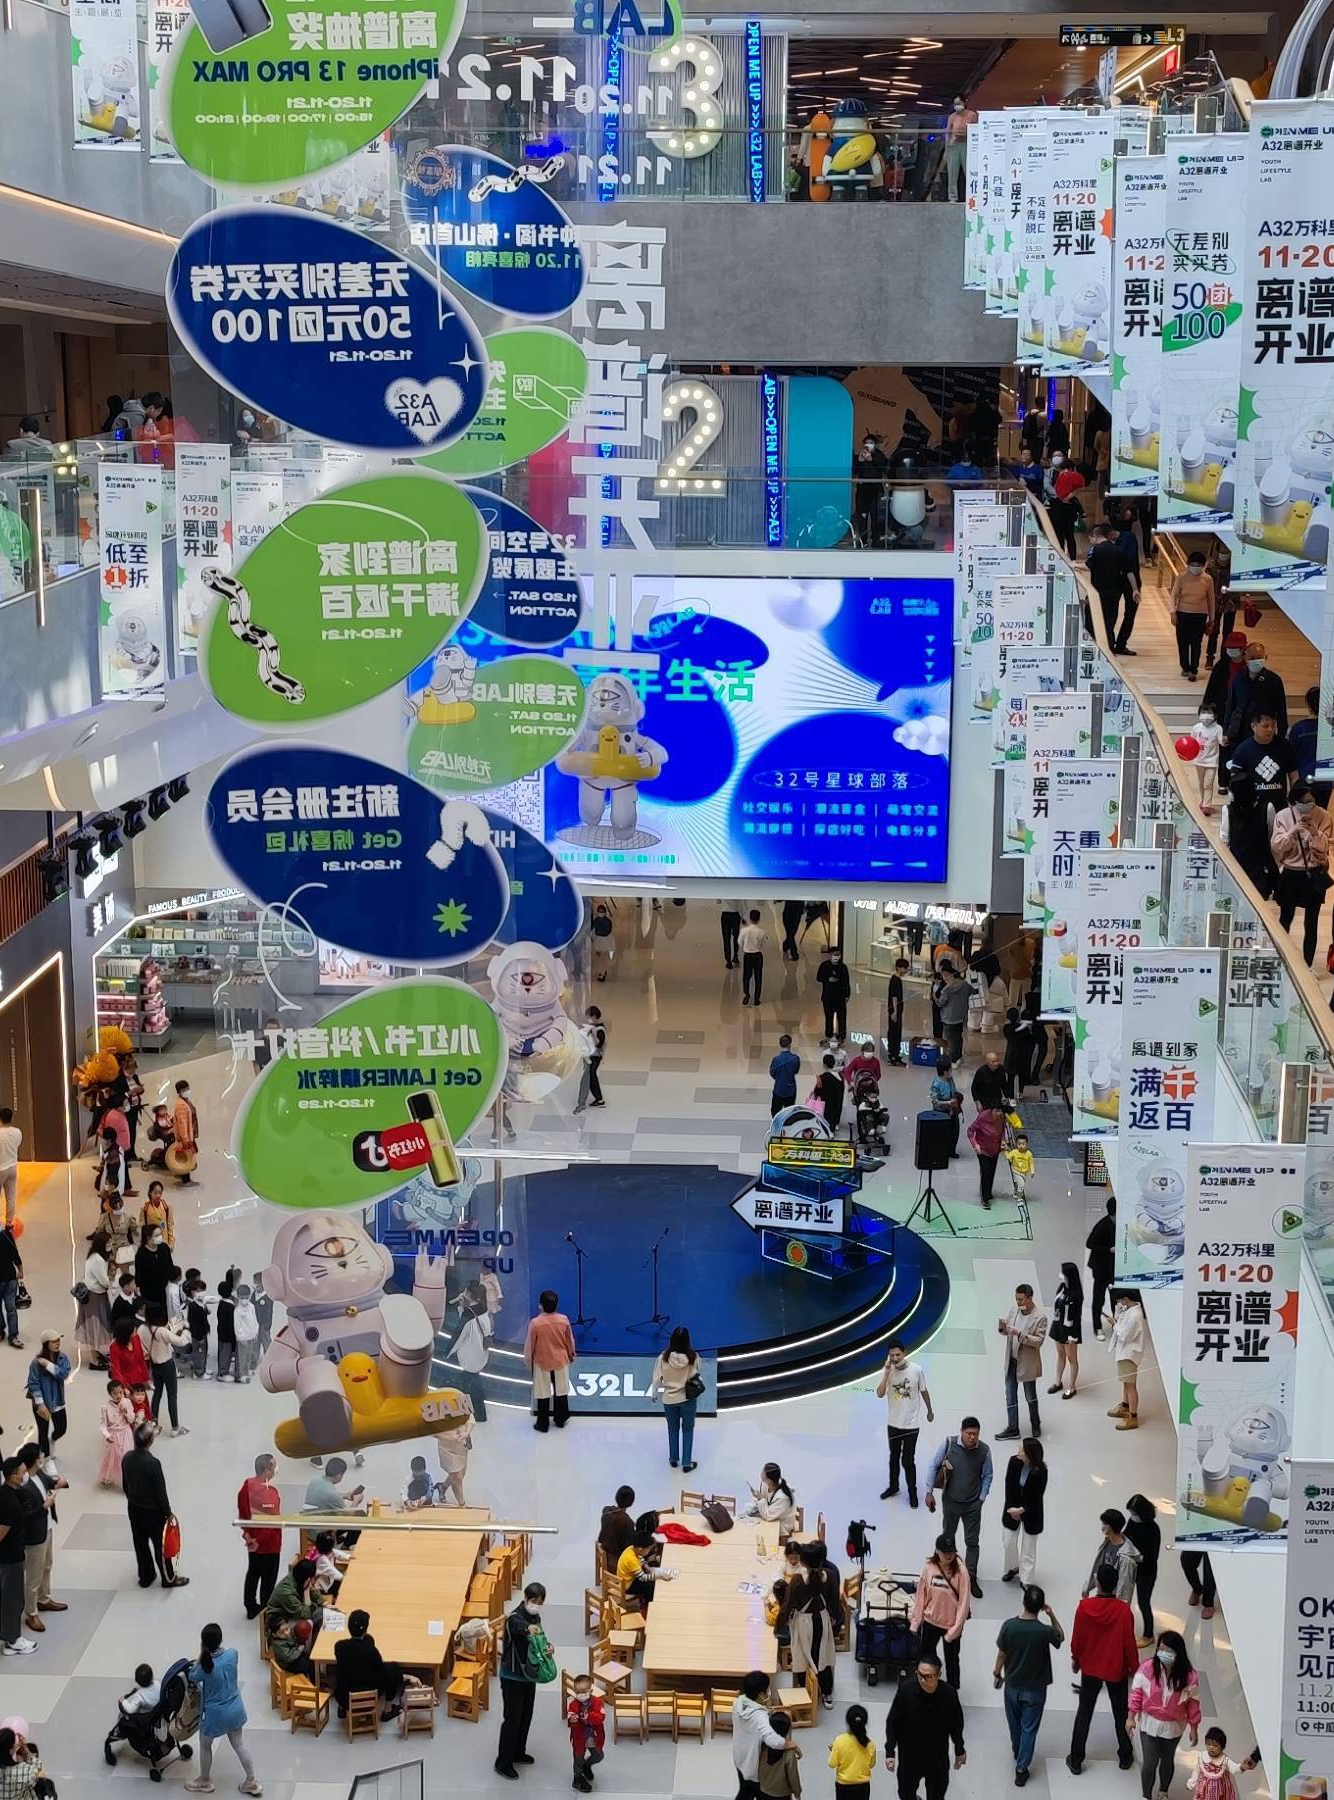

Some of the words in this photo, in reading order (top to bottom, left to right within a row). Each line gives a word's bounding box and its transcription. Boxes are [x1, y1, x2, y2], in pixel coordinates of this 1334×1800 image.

[648, 34, 724, 159] 3
[1053, 210, 1096, 232] 离谱
[1053, 234, 1096, 256] 开业
[1173, 231, 1229, 251] 无差别
[1172, 254, 1229, 273] 买买券
[1171, 312, 1226, 340] 100
[654, 379, 727, 497] 2
[183, 520, 218, 539] 离谱
[105, 543, 149, 565] 低至
[183, 540, 219, 558] 开业
[774, 772, 908, 789] 32号星球部落
[148, 899, 178, 913] FAMOUS
[181, 892, 208, 906] BEAUTY
[1087, 919, 1141, 929] A32万科里
[1128, 1101, 1194, 1132] 返百
[754, 1200, 834, 1224] 离谱开业
[1197, 1243, 1275, 1258] A32万科里
[1196, 1290, 1272, 1326] 离谱
[1194, 1328, 1270, 1363] 开业
